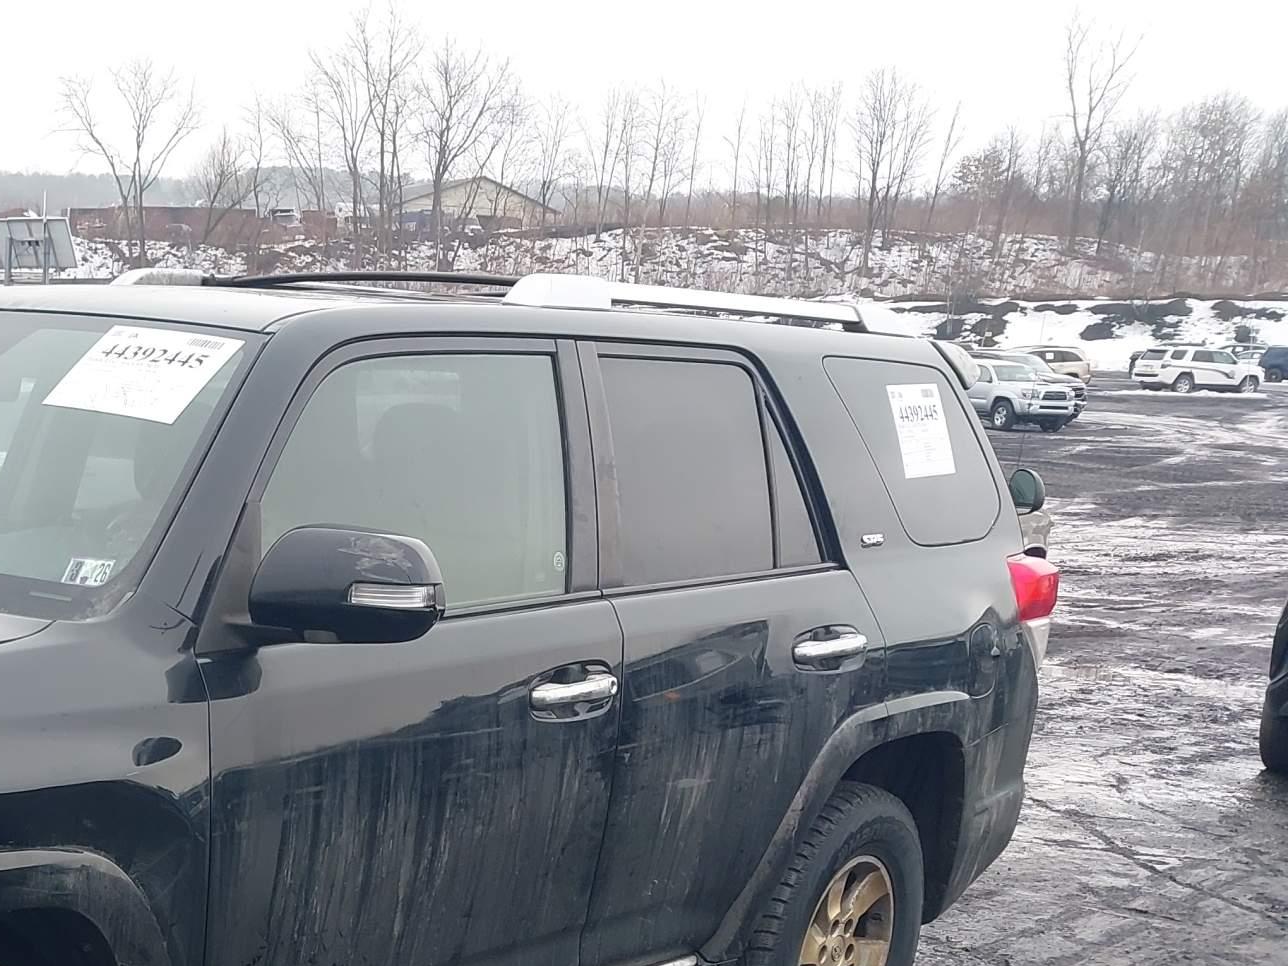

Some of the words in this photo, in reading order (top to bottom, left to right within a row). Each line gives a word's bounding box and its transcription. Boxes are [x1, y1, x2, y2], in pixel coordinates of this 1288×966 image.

[102, 343, 210, 369] 44392445
[898, 404, 939, 423] 44392445
[93, 562, 112, 583] 26
